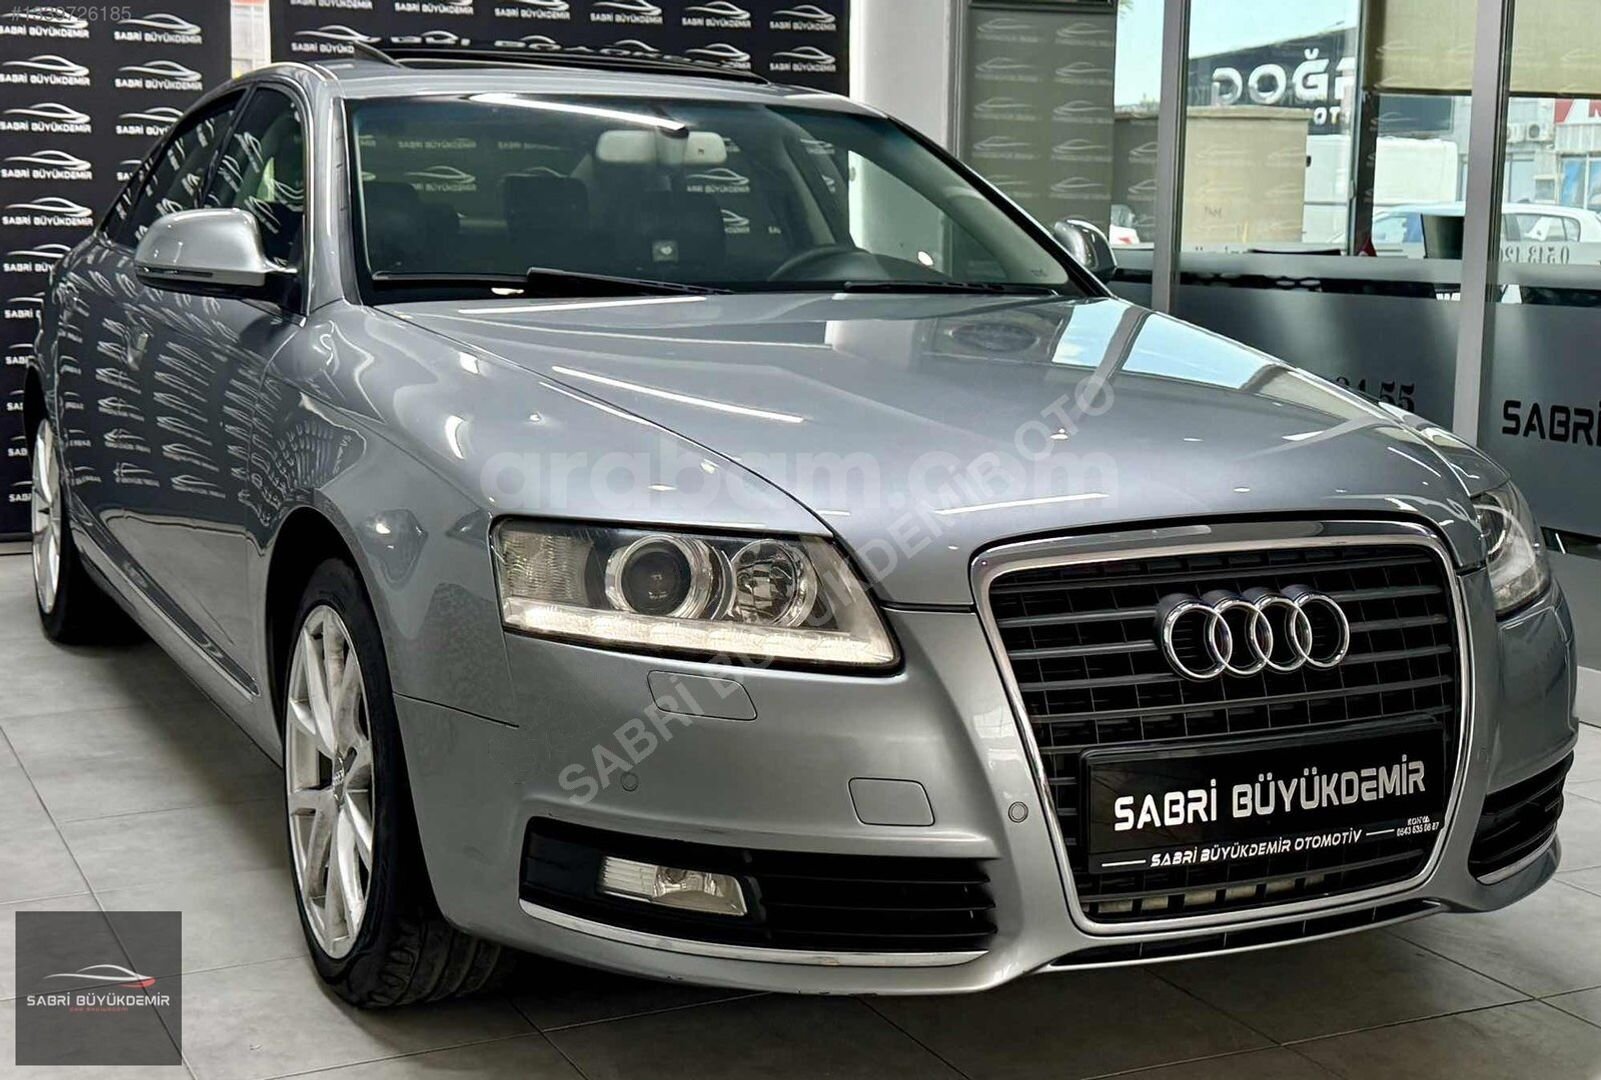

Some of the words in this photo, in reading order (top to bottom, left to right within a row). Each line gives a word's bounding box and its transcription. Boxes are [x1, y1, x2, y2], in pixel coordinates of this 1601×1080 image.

[114, 30, 143, 42] SABRİ
[115, 77, 143, 89] SABRİ
[115, 124, 144, 136] SABRİ
[0, 167, 30, 179] SABRİ
[2, 215, 31, 226] SABRİ
[3, 262, 33, 273] SABRİ
[4, 307, 34, 319] SABRİ
[1113, 778, 1217, 832] SABRİ
[1231, 754, 1426, 819] BÜYÜKDEMİR
[1150, 846, 1197, 868] SABRİ
[1200, 836, 1291, 863] BÜYÜKDEMİR
[1294, 827, 1362, 851] OTOMOTİV
